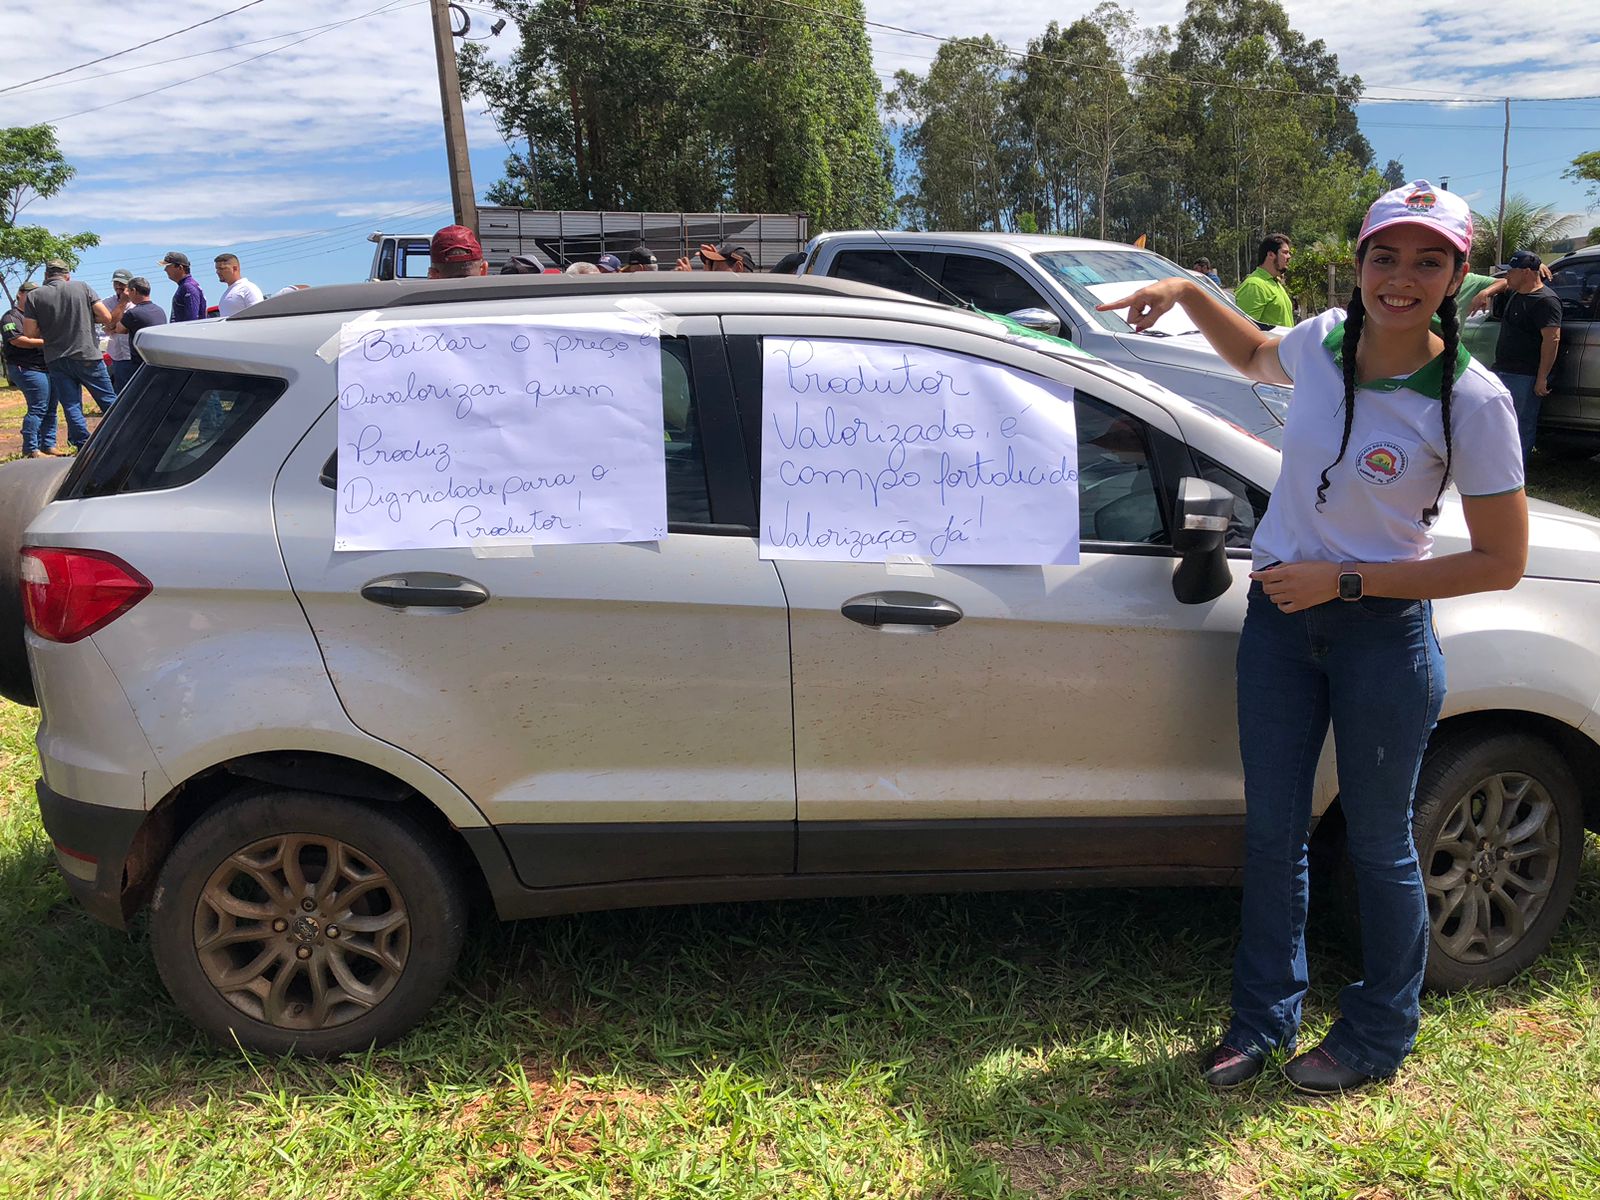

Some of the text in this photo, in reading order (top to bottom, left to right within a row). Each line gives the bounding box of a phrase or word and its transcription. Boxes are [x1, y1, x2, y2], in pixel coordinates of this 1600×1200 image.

[357, 329, 486, 361] Baixar
[544, 334, 629, 363] preço
[772, 338, 970, 395] Produtor
[525, 380, 614, 408] quem
[343, 476, 497, 522] Dignidade
[501, 472, 575, 505] para
[933, 445, 1079, 506] fortalecido
[768, 500, 917, 559] Valorização
